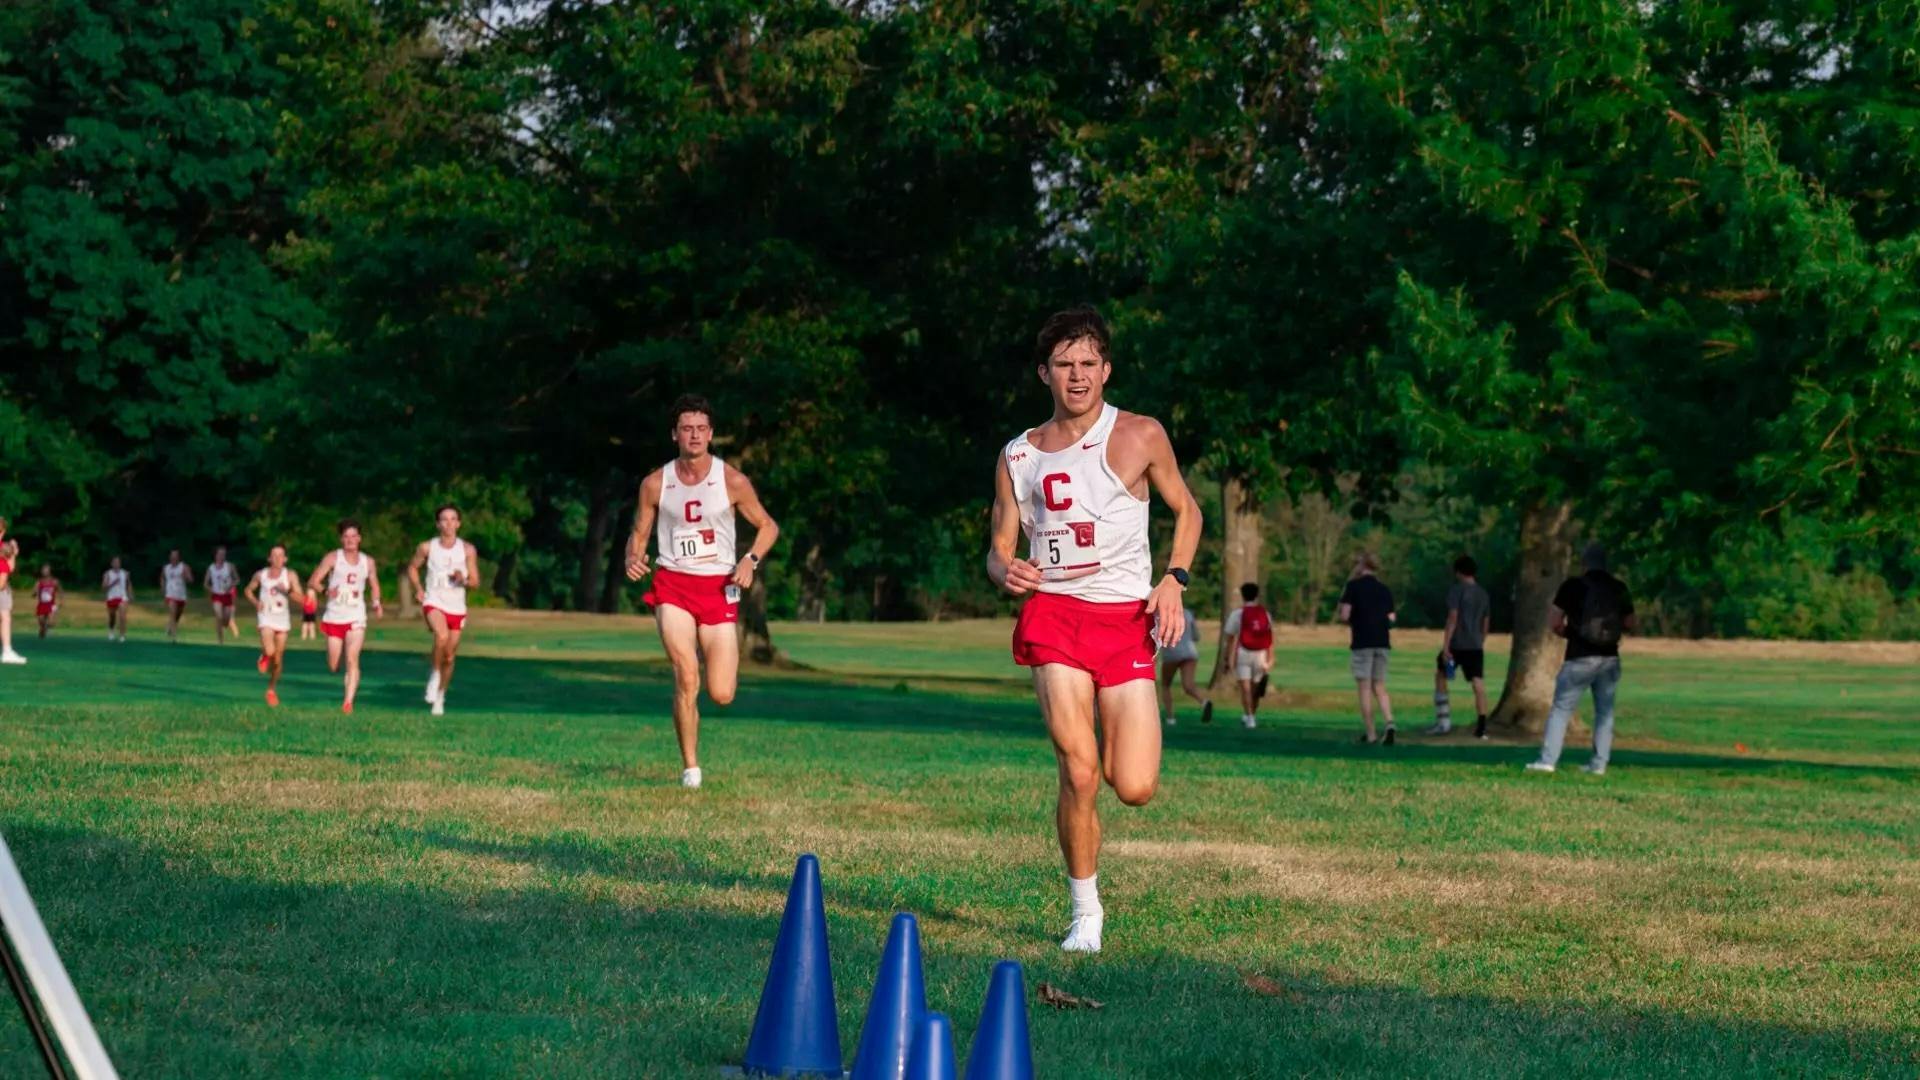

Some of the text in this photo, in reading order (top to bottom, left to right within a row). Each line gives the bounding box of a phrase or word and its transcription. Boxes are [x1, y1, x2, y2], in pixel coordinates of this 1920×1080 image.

[1042, 472, 1073, 512] C
[684, 500, 702, 523] C
[680, 539, 697, 557] 10
[1048, 539, 1061, 565] 5
